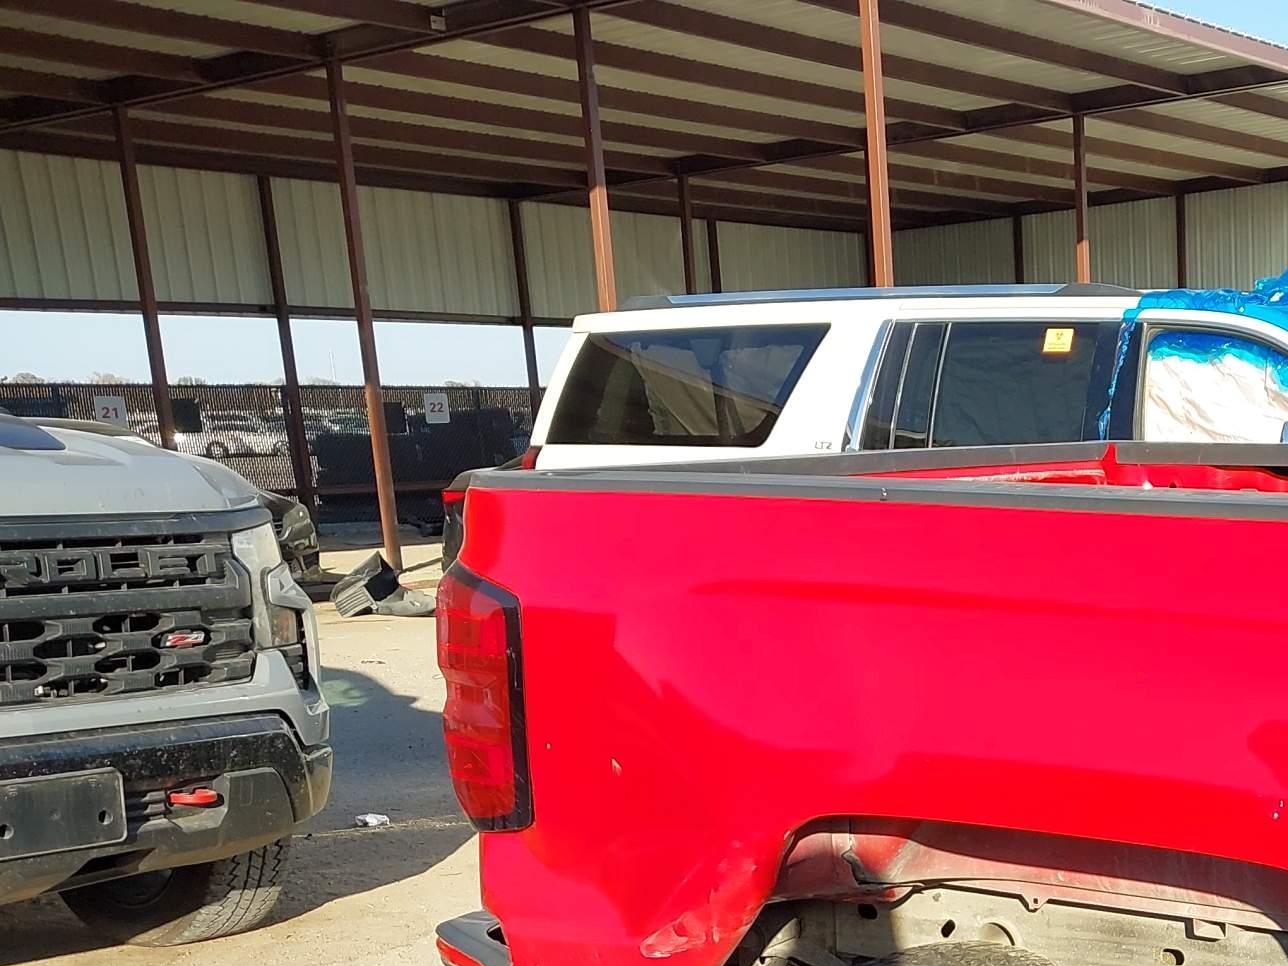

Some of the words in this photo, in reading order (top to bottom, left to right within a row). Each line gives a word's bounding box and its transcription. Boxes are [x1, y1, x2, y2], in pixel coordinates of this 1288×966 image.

[101, 406, 119, 419] 21
[429, 401, 444, 413] 22
[814, 440, 832, 450] LTZ
